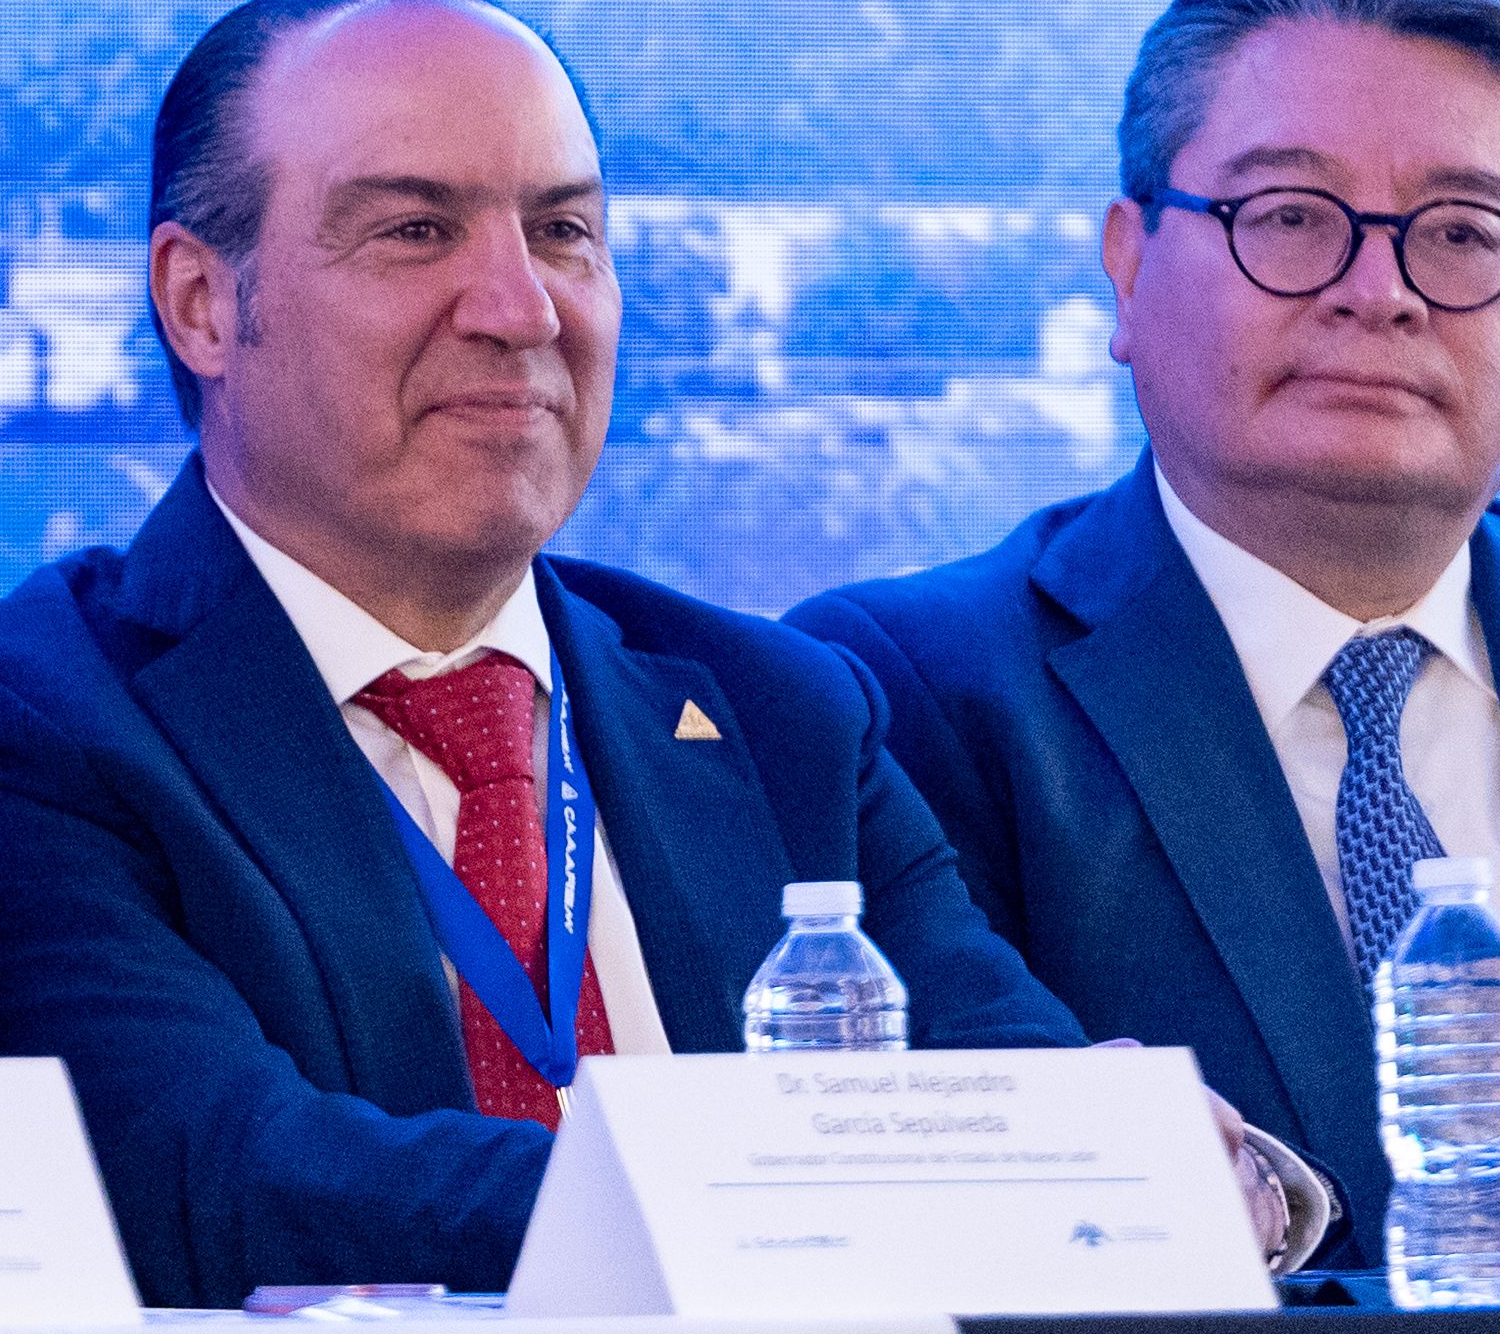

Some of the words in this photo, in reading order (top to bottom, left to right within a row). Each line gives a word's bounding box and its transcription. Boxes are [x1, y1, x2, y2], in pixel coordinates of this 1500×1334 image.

[775, 1071, 810, 1095] Dr.
[812, 1070, 900, 1094] Samuel
[907, 1070, 1016, 1098] Alejandro
